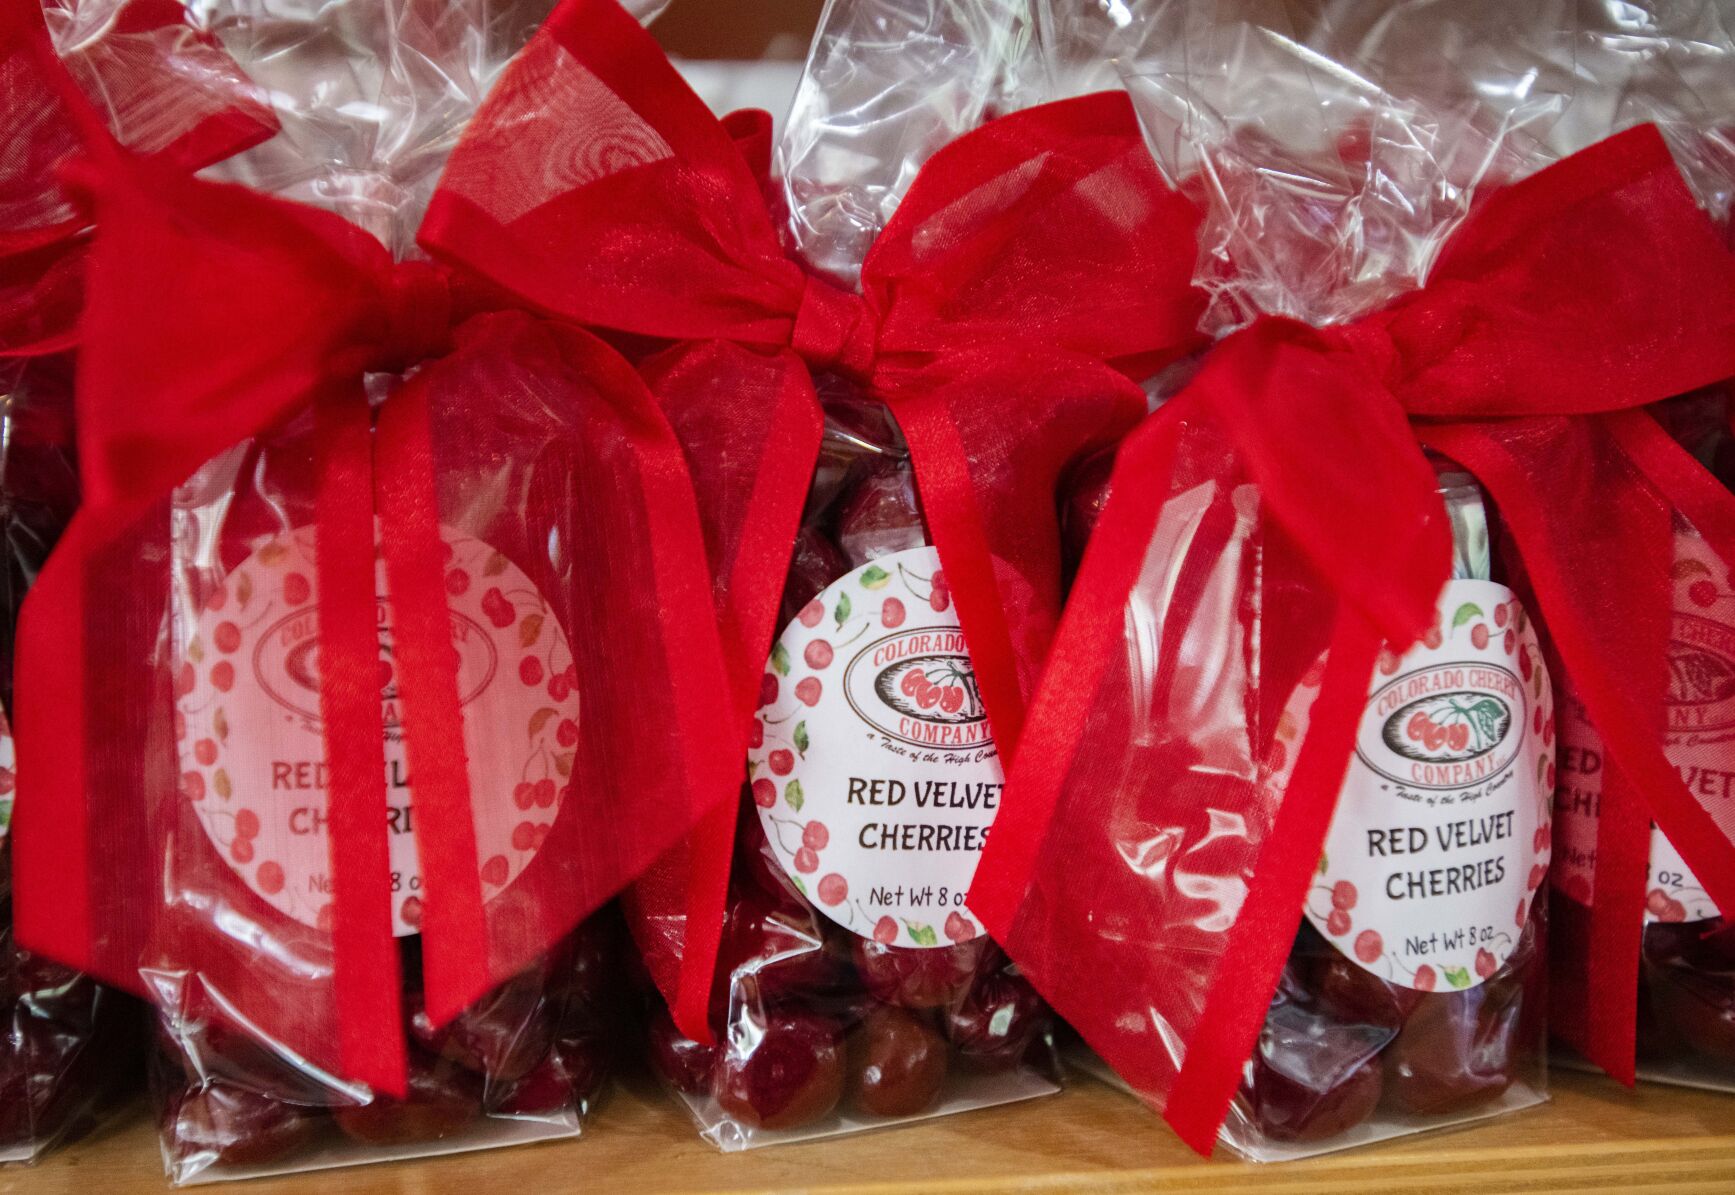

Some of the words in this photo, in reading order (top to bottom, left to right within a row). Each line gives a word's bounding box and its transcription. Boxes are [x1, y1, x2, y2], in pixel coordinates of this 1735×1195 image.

[874, 633, 965, 667] COLORADO
[1377, 669, 1464, 717] COLORADO
[899, 717, 990, 746] COMPANY
[880, 736, 907, 756] Taste
[909, 751, 922, 763] of
[922, 752, 940, 764] the
[943, 750, 971, 767] High
[1411, 752, 1497, 785] COMPANY
[847, 777, 907, 806] RED
[913, 780, 1004, 810] VELVE
[1367, 827, 1428, 857] RED
[1436, 810, 1515, 852] VELVET
[308, 874, 332, 893] Ne
[1386, 856, 1506, 900] CHERRIES
[869, 885, 905, 907] Net
[910, 885, 934, 907] Wt
[938, 887, 948, 906] 8
[953, 892, 966, 907] o
[1405, 933, 1438, 956] Net
[1443, 928, 1465, 951] Wt
[1469, 926, 1477, 946] 8
